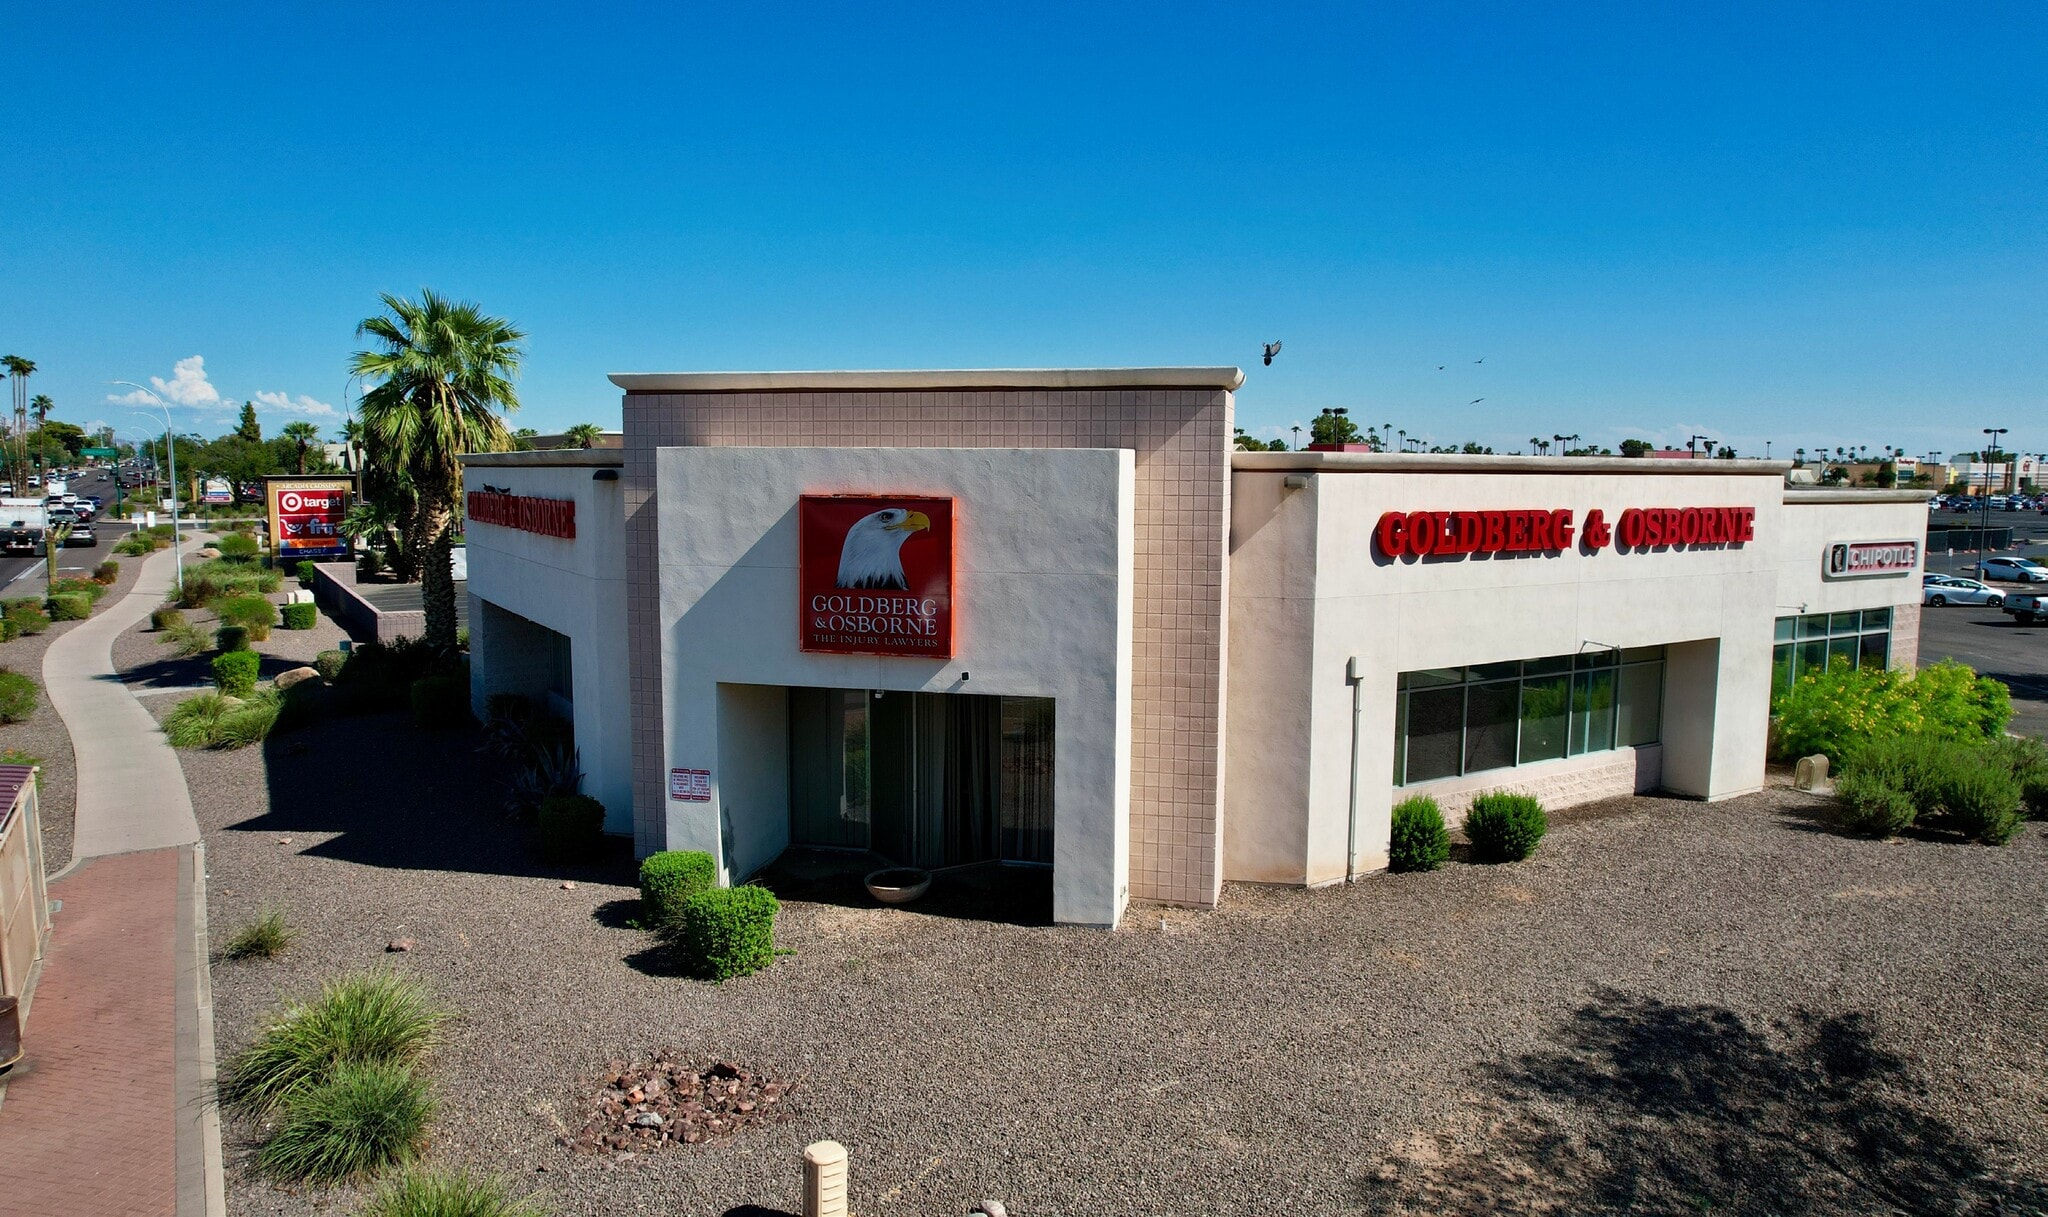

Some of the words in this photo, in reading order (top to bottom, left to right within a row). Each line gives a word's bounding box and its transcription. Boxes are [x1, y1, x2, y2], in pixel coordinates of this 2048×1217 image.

[303, 496, 341, 509] target
[519, 497, 570, 537] OSBORNE
[1377, 509, 1575, 556] GOLDBERG
[1583, 509, 1611, 548] &
[1620, 507, 1755, 546] OSBORNE
[1850, 545, 1916, 566] CHIPOTLE
[812, 595, 938, 616] GOLDBERG
[813, 633, 836, 643] THE
[840, 635, 880, 646] INJURY
[885, 637, 938, 648] LAWYERS
